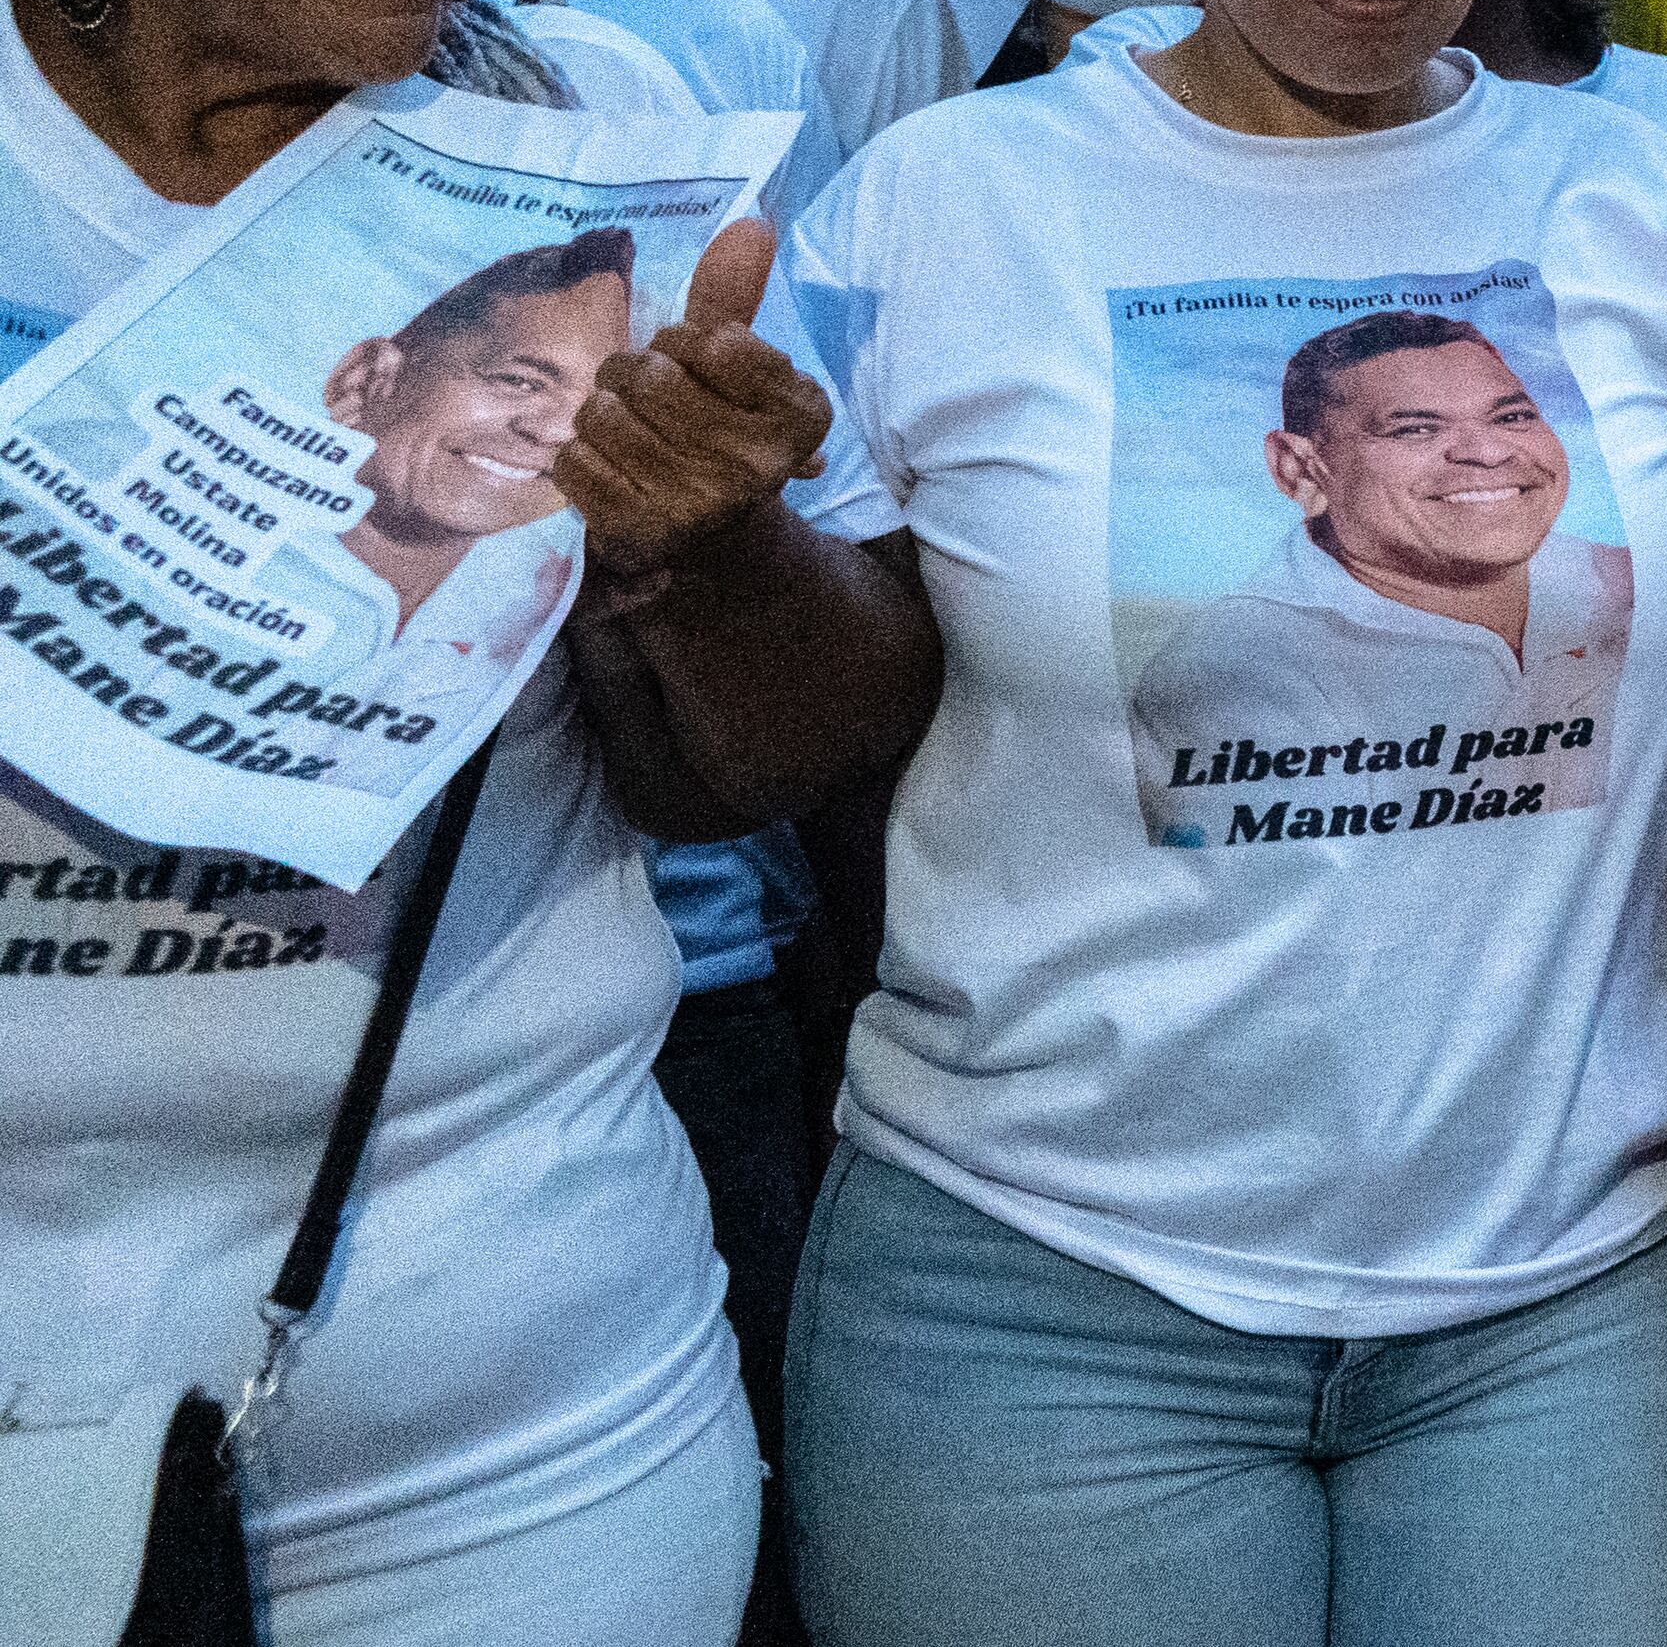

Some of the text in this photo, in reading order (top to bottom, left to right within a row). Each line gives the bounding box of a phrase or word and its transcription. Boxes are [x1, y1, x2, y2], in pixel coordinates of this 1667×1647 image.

[416, 166, 510, 209] familia
[513, 192, 541, 212] te
[1175, 291, 1269, 313] familia
[1275, 292, 1301, 310] te
[1308, 290, 1394, 315] espera
[1400, 289, 1444, 307] con
[155, 394, 353, 513] Campuzano
[223, 387, 349, 465] Familia
[125, 478, 247, 568] Molina
[163, 449, 278, 532] Ustate
[0, 437, 306, 641] Unidos en oración
[166, 710, 338, 781] Díaz
[248, 680, 437, 744] para
[1167, 716, 1597, 788] Libertad para
[1225, 778, 1546, 846] Mane Díaz
[122, 916, 327, 976] Díaz
